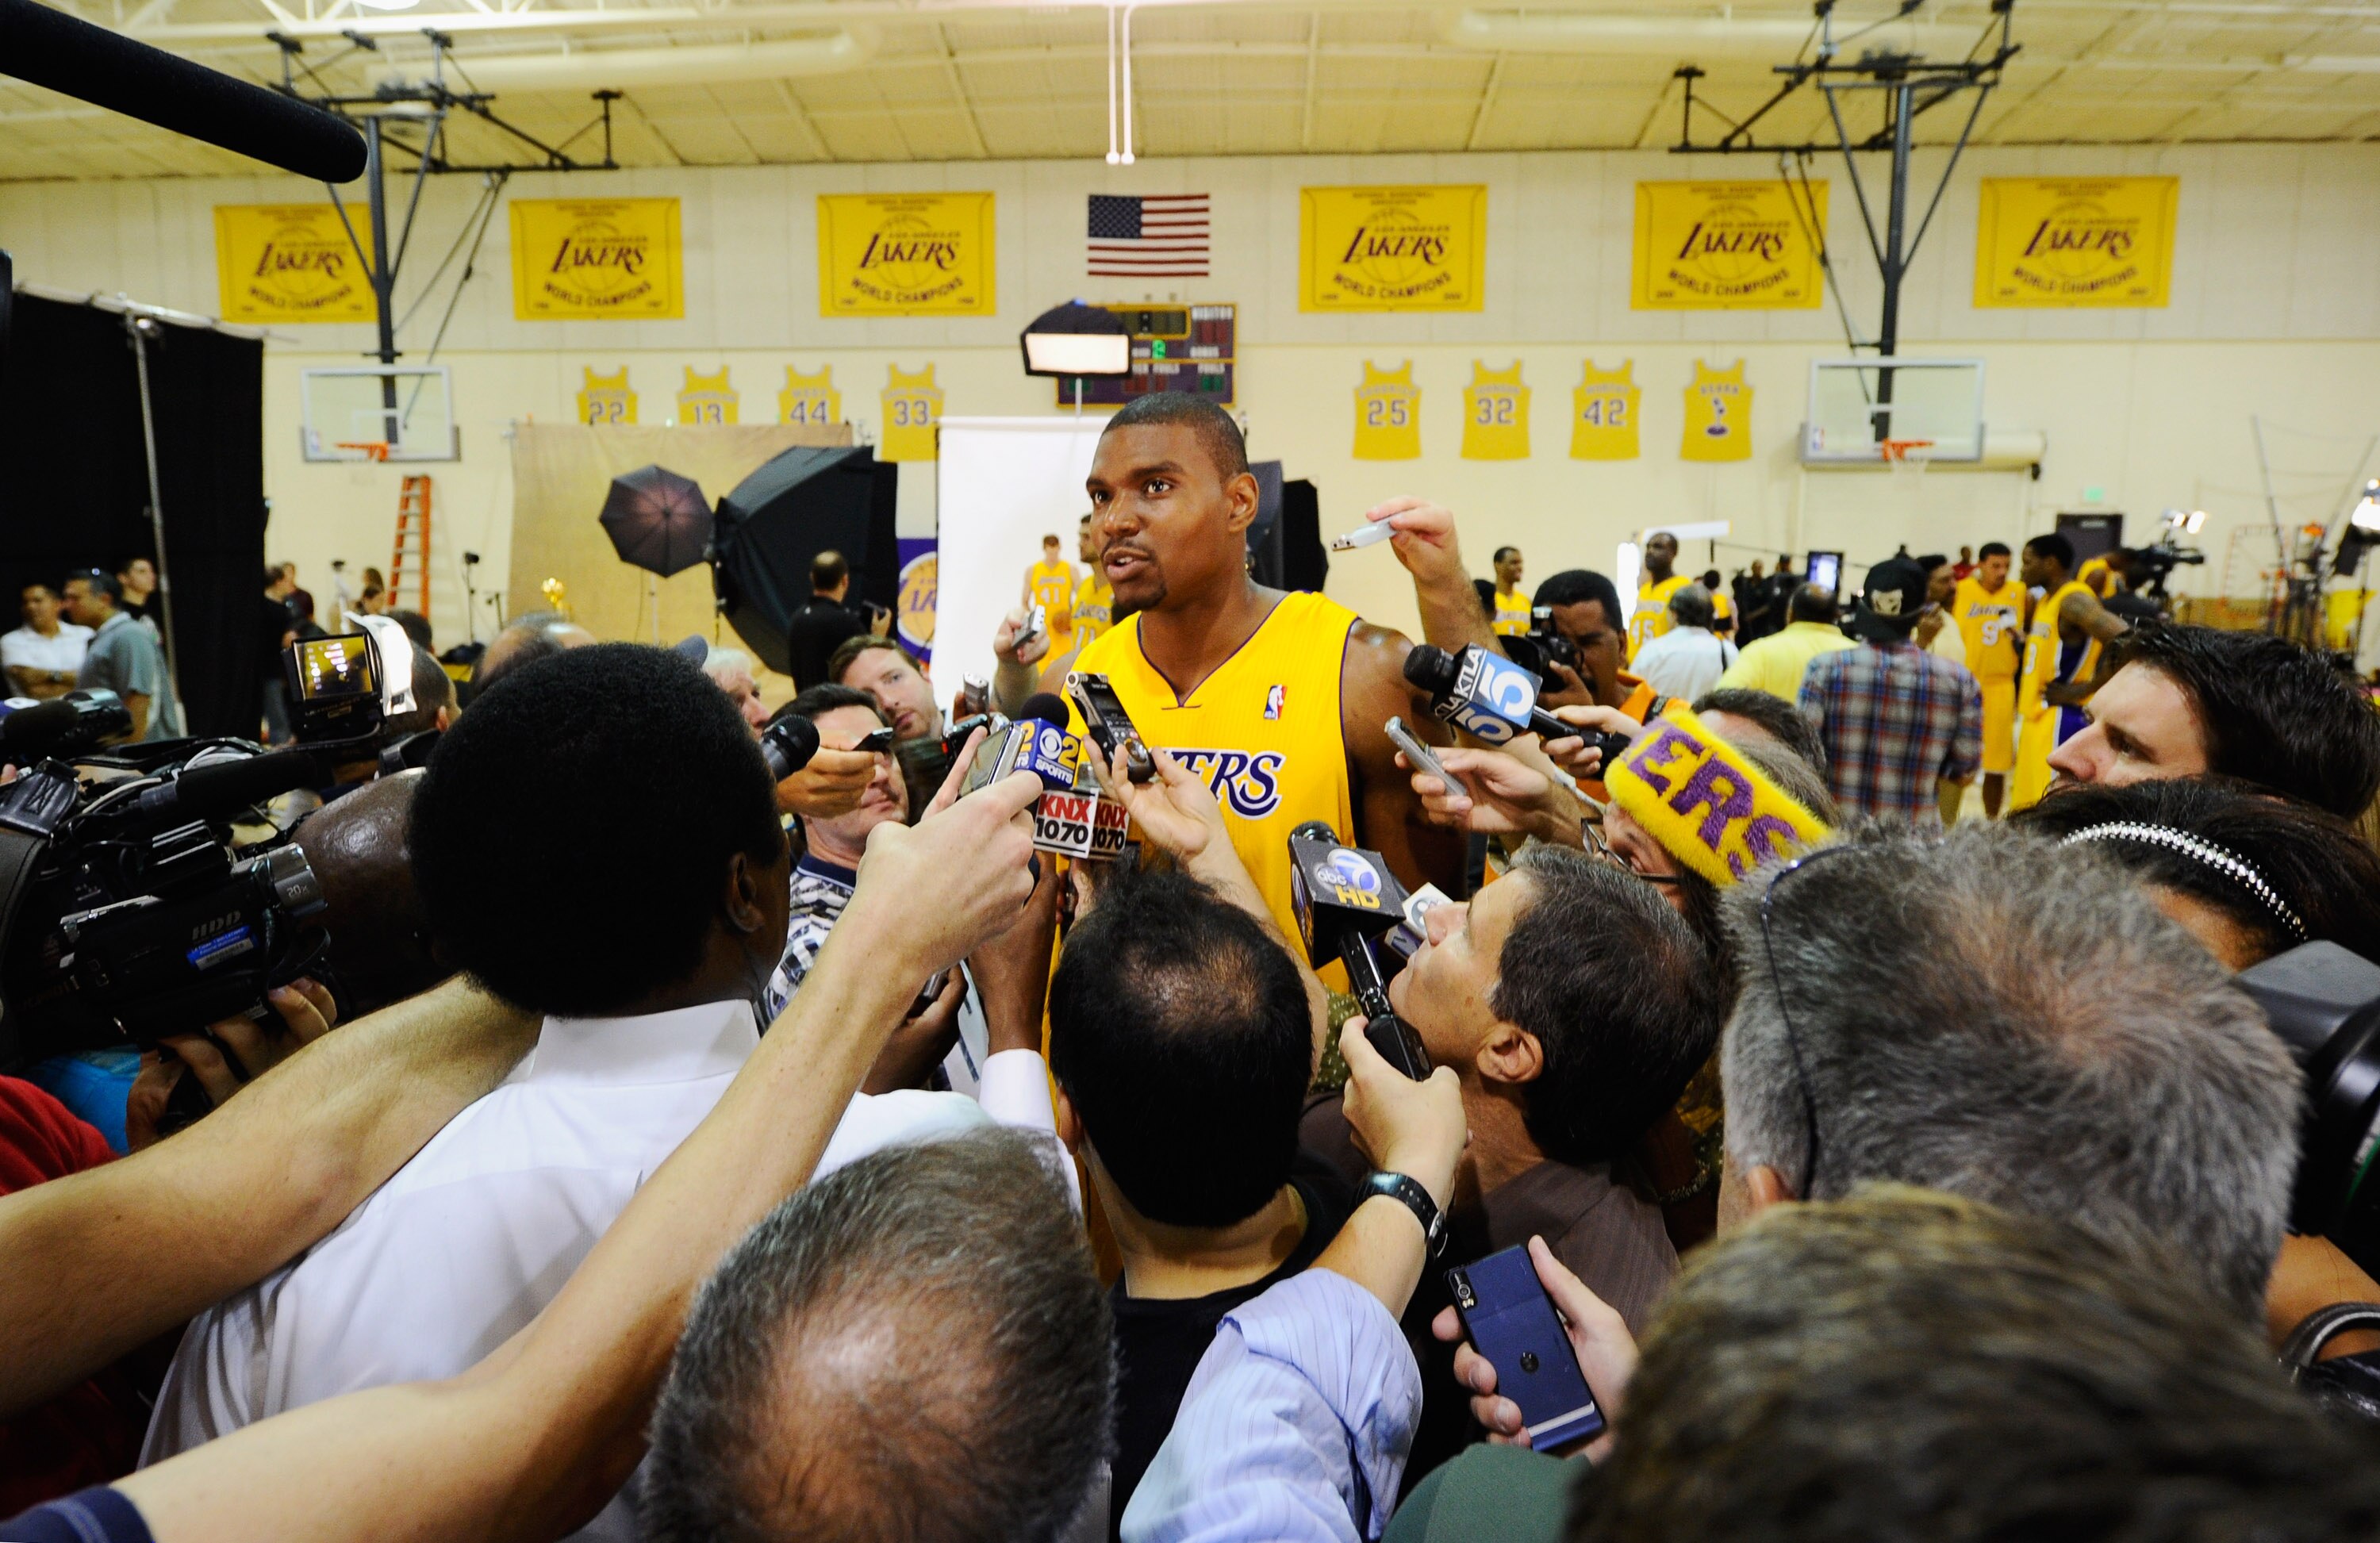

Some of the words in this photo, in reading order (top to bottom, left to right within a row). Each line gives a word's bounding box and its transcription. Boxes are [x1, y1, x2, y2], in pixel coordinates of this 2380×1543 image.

[860, 232, 957, 271] LAKERS
[1342, 226, 1447, 266] LAKERS
[1678, 221, 1787, 263] LAKERS
[2024, 218, 2136, 259] LAKERS
[551, 237, 645, 274] LAKERS
[544, 281, 583, 305] WORLD
[587, 279, 652, 306] CHAMPIONS
[851, 277, 892, 302] WORLD
[896, 275, 964, 303] CHAMPIONS
[1334, 271, 1376, 298] WORLD
[1380, 271, 1452, 299] CHAMPIONS
[1668, 268, 1712, 294] WORLD
[1716, 268, 1791, 295] CHAMPIONS
[2013, 266, 2057, 292] WORLD
[2061, 266, 2139, 294] CHAMPIONS
[589, 401, 624, 424] 22
[789, 399, 828, 424] 44
[893, 399, 931, 427] 33
[1366, 398, 1408, 427] 25
[1476, 397, 1516, 425] 32
[1583, 398, 1627, 427] 42
[1453, 647, 1484, 699] KTLA
[1478, 662, 1535, 717] 5
[1058, 735, 1079, 770] 2
[1035, 761, 1074, 785] SPORTS
[1152, 747, 1287, 821] ERS
[1038, 793, 1092, 823] KNX
[1095, 801, 1129, 829] KNX
[1317, 868, 1347, 886] abc
[1334, 884, 1380, 909] HD
